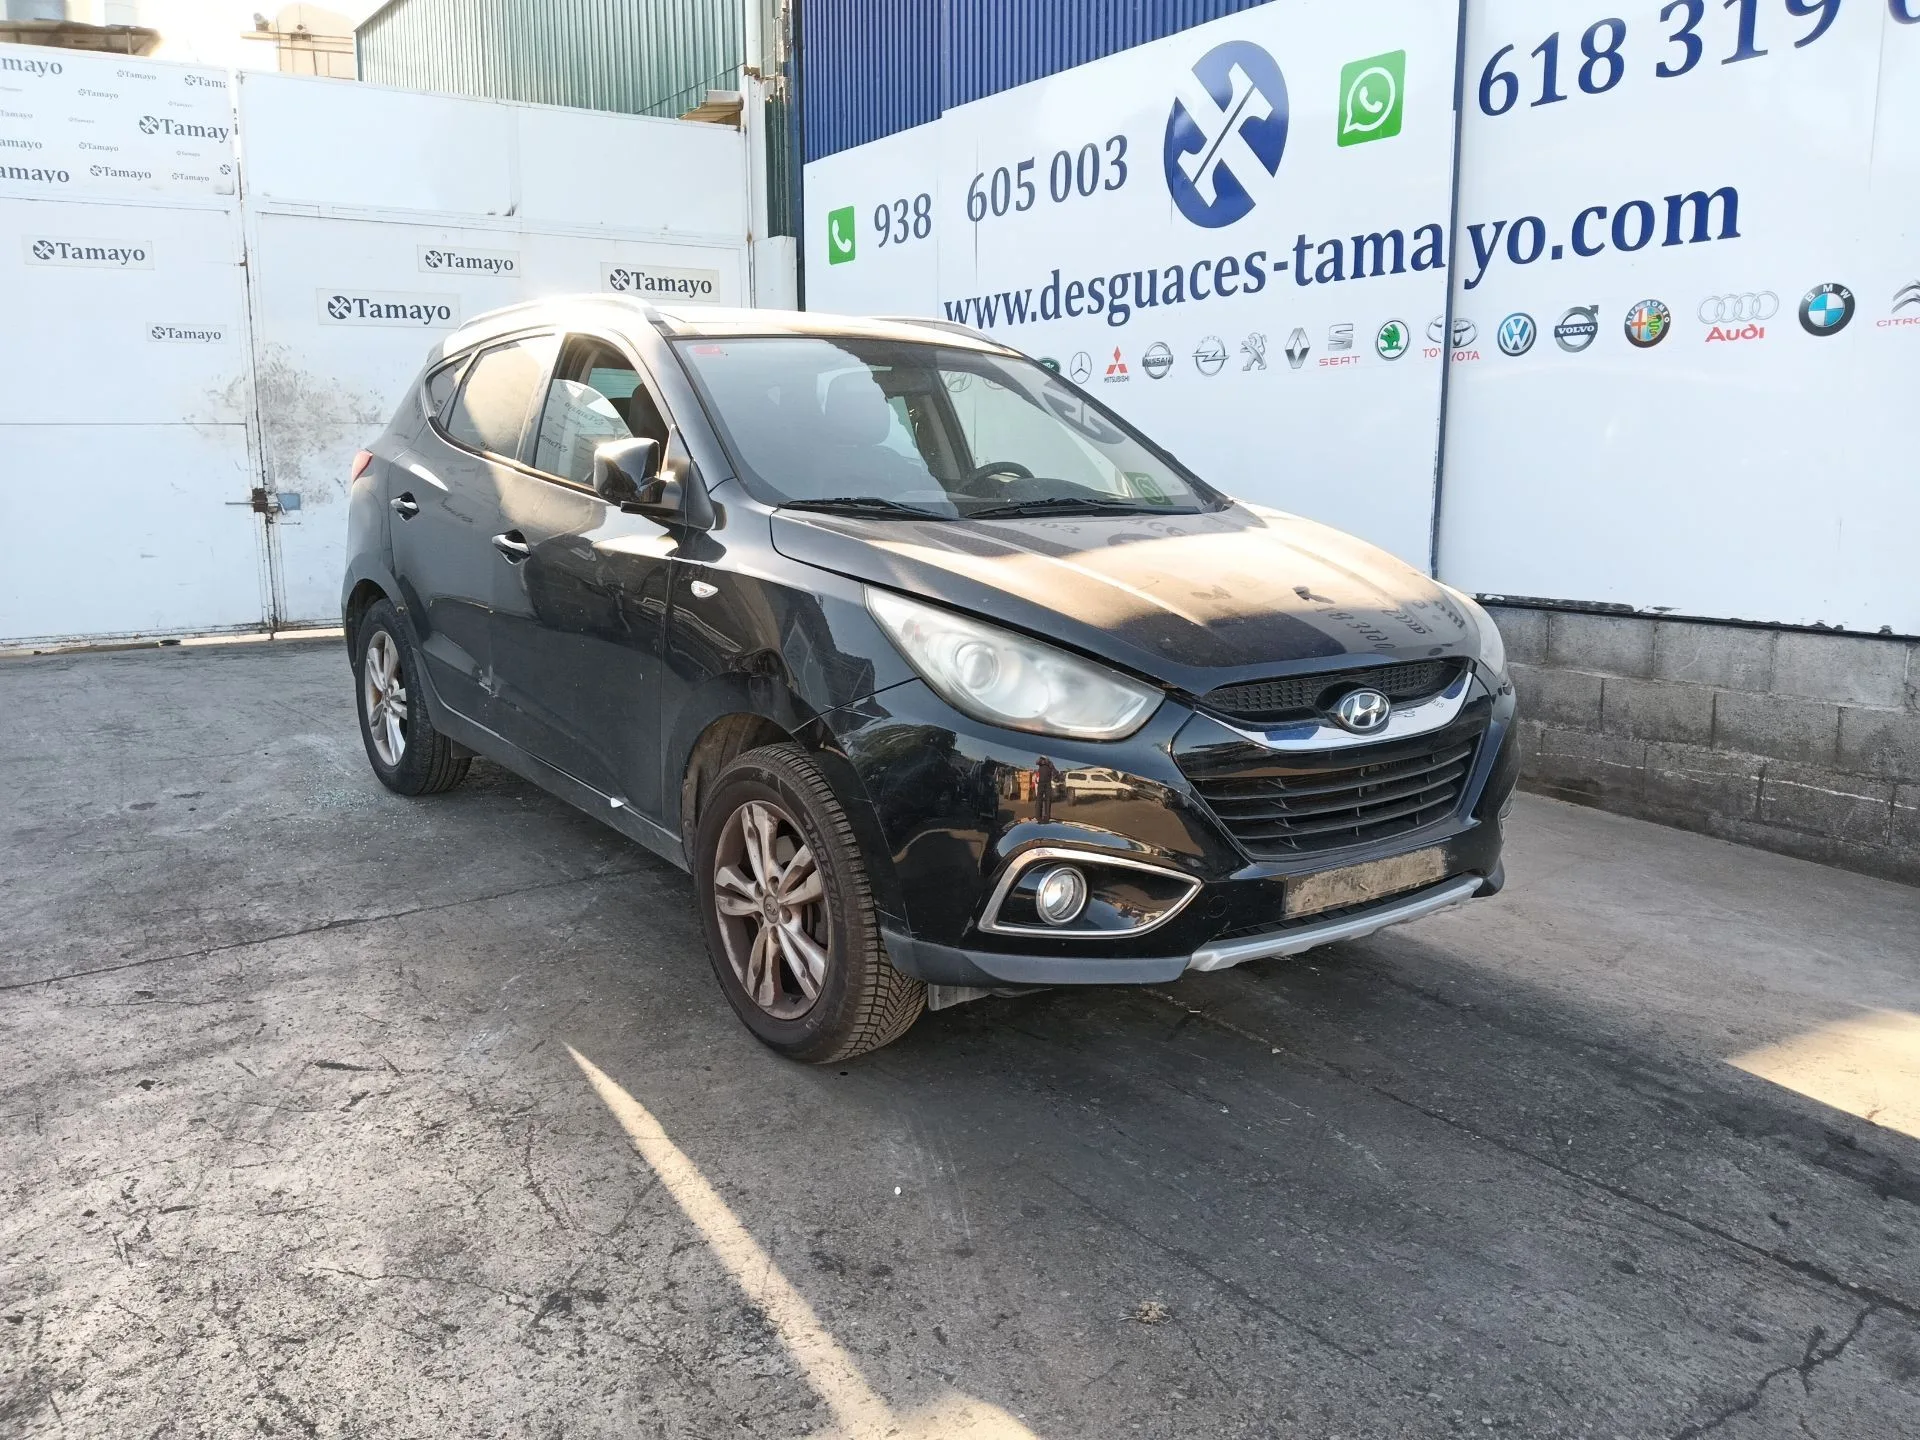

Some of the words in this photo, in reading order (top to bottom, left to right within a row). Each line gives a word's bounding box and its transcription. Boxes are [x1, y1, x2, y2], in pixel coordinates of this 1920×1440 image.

[2, 57, 63, 78] mayo
[124, 70, 157, 81] Tamayo
[1477, 17, 1628, 117] 618
[86, 89, 119, 99] Tamayo
[0, 109, 33, 119] Tamayo
[160, 118, 229, 143] Tamay
[87, 142, 119, 152] Tamayo
[102, 166, 152, 181] Tamayo
[179, 173, 210, 182] Tamayo
[874, 193, 932, 248] 938
[967, 156, 1036, 222] 605
[1050, 134, 1128, 204] 003
[56, 241, 146, 266] Tamayo
[943, 185, 1742, 329] www.desguaces-tamayo.com
[444, 252, 514, 275] Tamayo
[632, 271, 713, 298] Tamayo
[1805, 283, 1851, 302] BMW
[353, 298, 452, 325] Tamayo
[165, 327, 222, 344] Tamayo
[1557, 324, 1595, 335] VOLVO
[1705, 323, 1765, 343] Audi
[1319, 355, 1361, 367] SEAT
